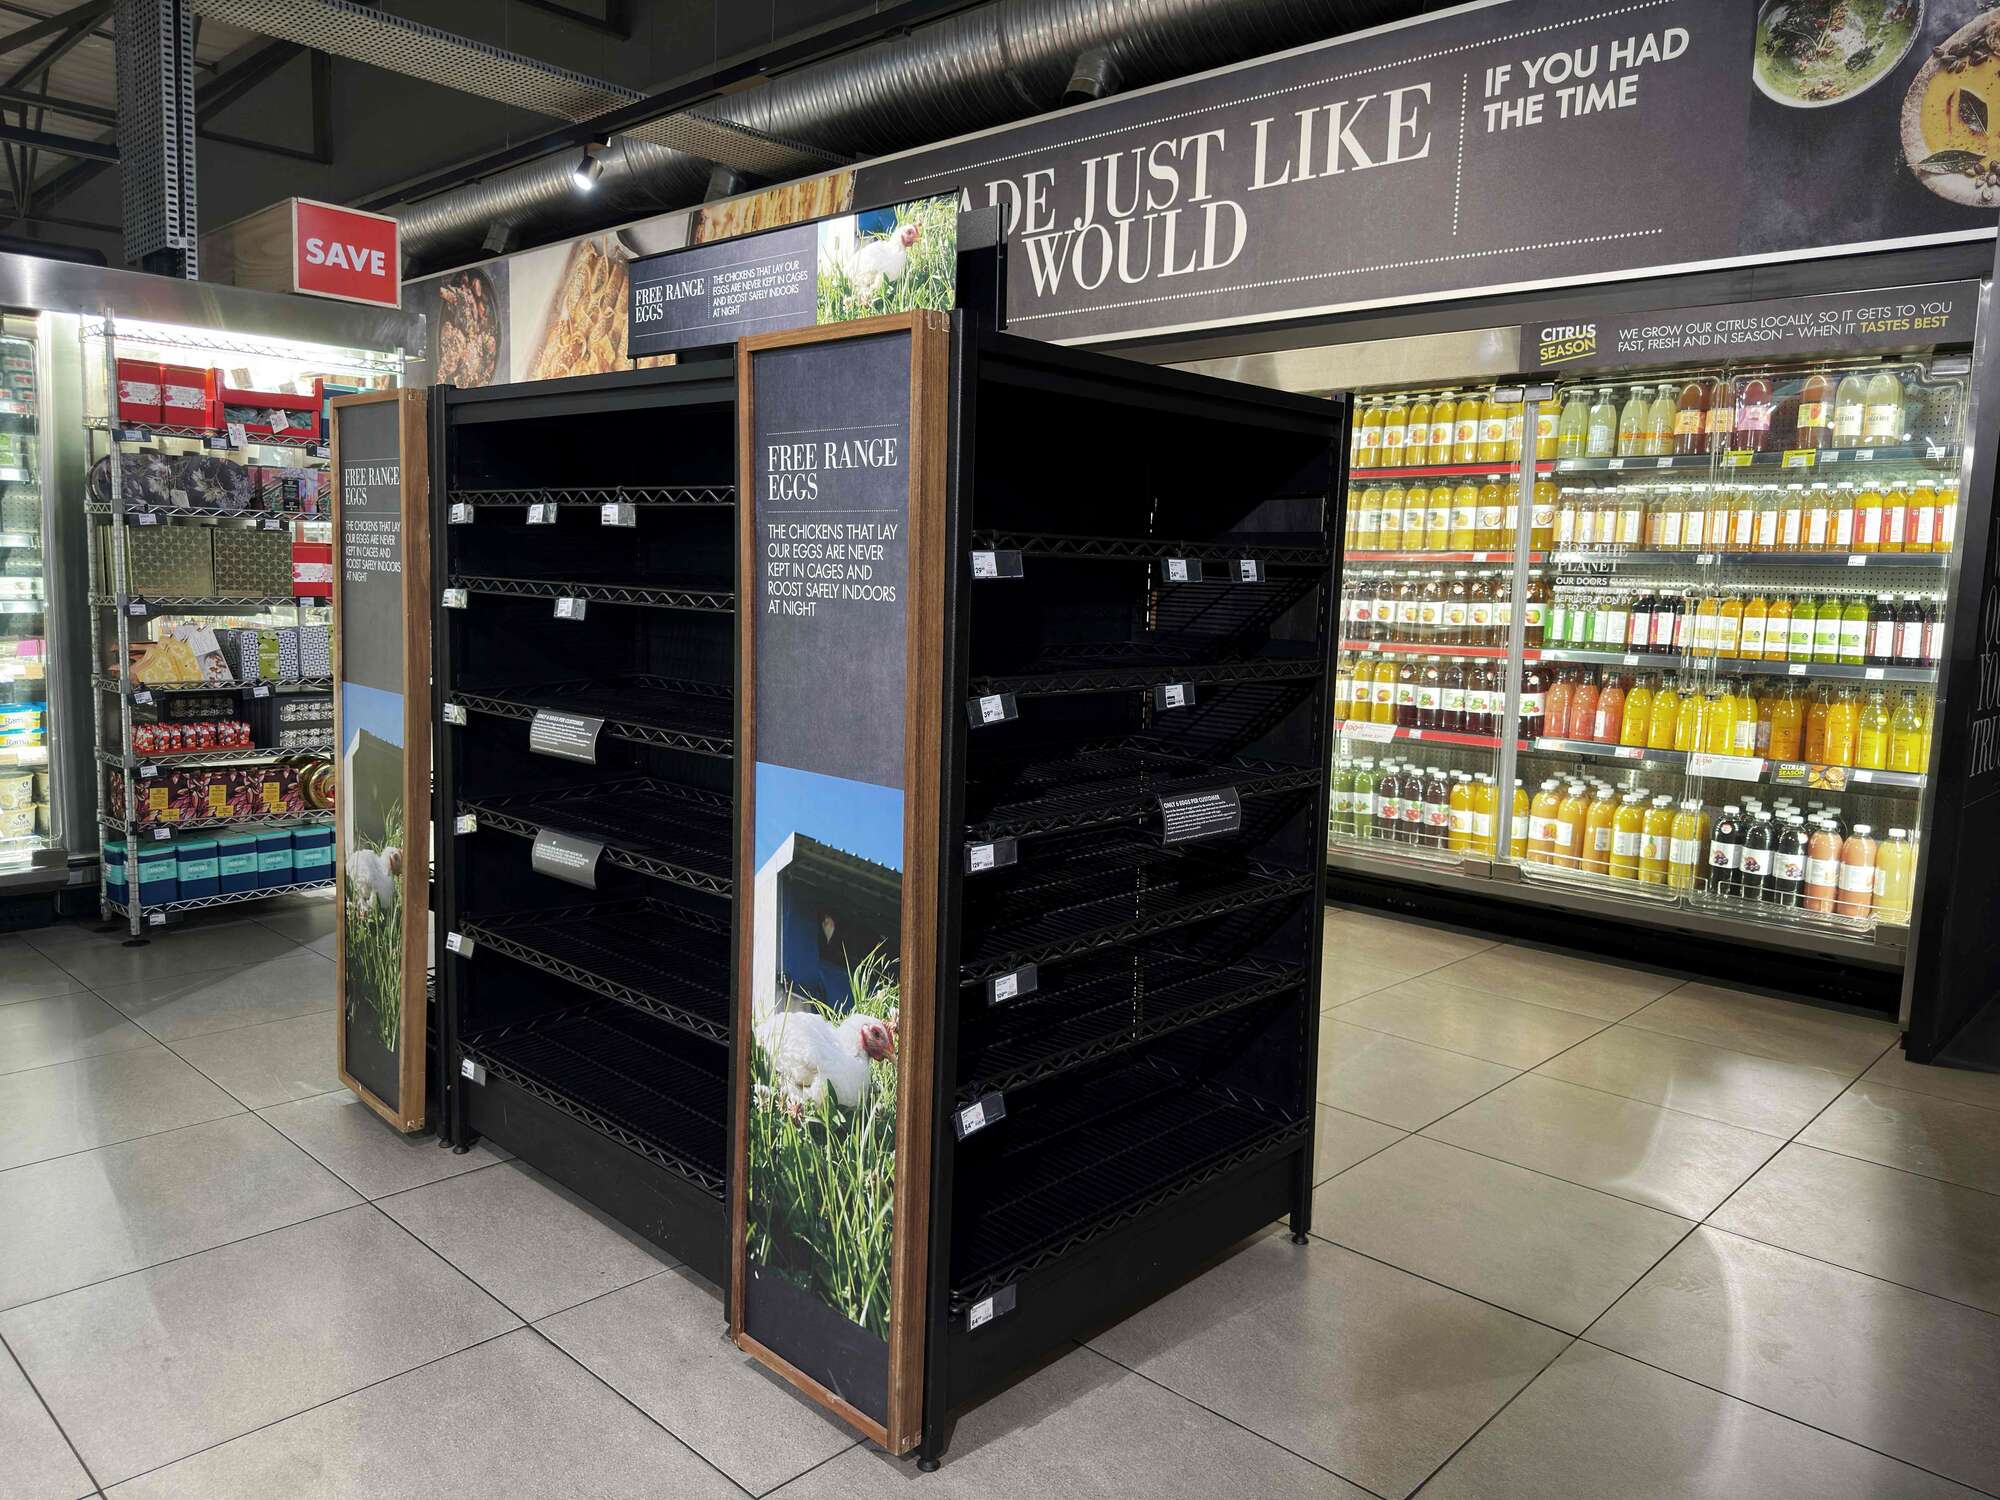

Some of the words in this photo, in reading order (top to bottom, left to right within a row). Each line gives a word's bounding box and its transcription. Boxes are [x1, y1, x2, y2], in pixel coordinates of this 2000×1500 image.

[1484, 64, 1512, 98] IF
[1521, 39, 1600, 91] YOU
[1608, 27, 1690, 72] HAD
[1482, 95, 1543, 133] THE
[1555, 75, 1640, 120] TIME
[1074, 129, 1225, 233] JUST
[1247, 82, 1432, 191] LIKE
[305, 237, 386, 277] SAVE
[1021, 200, 1248, 298] WOULD
[713, 275, 724, 284] THE
[725, 268, 756, 283] CHICKENS
[756, 265, 772, 277] THAT
[773, 263, 784, 273] LAY
[785, 260, 800, 272] OUR
[713, 284, 729, 296] EGGS
[731, 282, 742, 293] ARE
[743, 279, 762, 291] NEVER
[763, 276, 777, 288] KEPT
[778, 275, 785, 284] IN
[786, 271, 808, 282] CAGES
[635, 286, 663, 306] FREE
[666, 278, 705, 300] RANGE
[713, 296, 726, 306] AND
[728, 292, 748, 304] ROOST
[749, 288, 768, 301] SAFELY
[769, 284, 799, 298] INDOORS
[635, 303, 663, 323] EGGS
[713, 309, 720, 318] AT
[721, 306, 741, 317] NIGHT
[1619, 329, 1639, 340] WE
[1642, 324, 1684, 338] GROW
[1686, 322, 1713, 334] OUR
[1715, 317, 1758, 332] CITRUS
[1761, 312, 1814, 329] LOCALLY,
[1818, 311, 1838, 323] SO
[1842, 310, 1853, 321] IT
[1857, 306, 1892, 320] GETS
[1896, 304, 1916, 317] TO
[1920, 301, 1953, 315] YOU
[1541, 324, 1597, 342] CITRUS
[1618, 339, 1645, 353] FAST,
[1648, 336, 1681, 350] FRESH
[1683, 334, 1711, 347] AND
[1714, 333, 1728, 345] IN
[1731, 328, 1783, 343] SEASON
[1798, 324, 1842, 338] WHEN
[1845, 322, 1856, 334] IT
[1860, 318, 1910, 334] TASTES
[1914, 315, 1950, 330] BEST
[1540, 337, 1597, 361] SEASON
[767, 443, 818, 472] FREE
[824, 438, 898, 470] RANGE
[345, 467, 366, 486] FREE
[368, 465, 400, 486] RANGE
[768, 472, 818, 500] EGGS
[345, 487, 367, 505] EGGS
[768, 524, 786, 539] THE
[789, 524, 843, 540] CHICKENS
[846, 524, 874, 540] THAT
[878, 524, 898, 540] LAY
[768, 543, 790, 558] OUR
[793, 544, 823, 559] EGGS
[825, 544, 845, 560] ARE
[849, 544, 884, 560] NEVER
[768, 562, 790, 577] KEPT
[793, 563, 804, 578] IN
[807, 563, 843, 579] CAGES
[847, 564, 872, 580] AND
[1558, 558, 1620, 573] PLANET
[768, 581, 803, 597] ROOST
[806, 583, 839, 599] SAFELY
[843, 584, 896, 602] INDOORS
[1556, 577, 1574, 585] OUR
[1576, 577, 1608, 586] DOORS
[768, 600, 780, 614] AT
[783, 600, 816, 616] NIGHT
